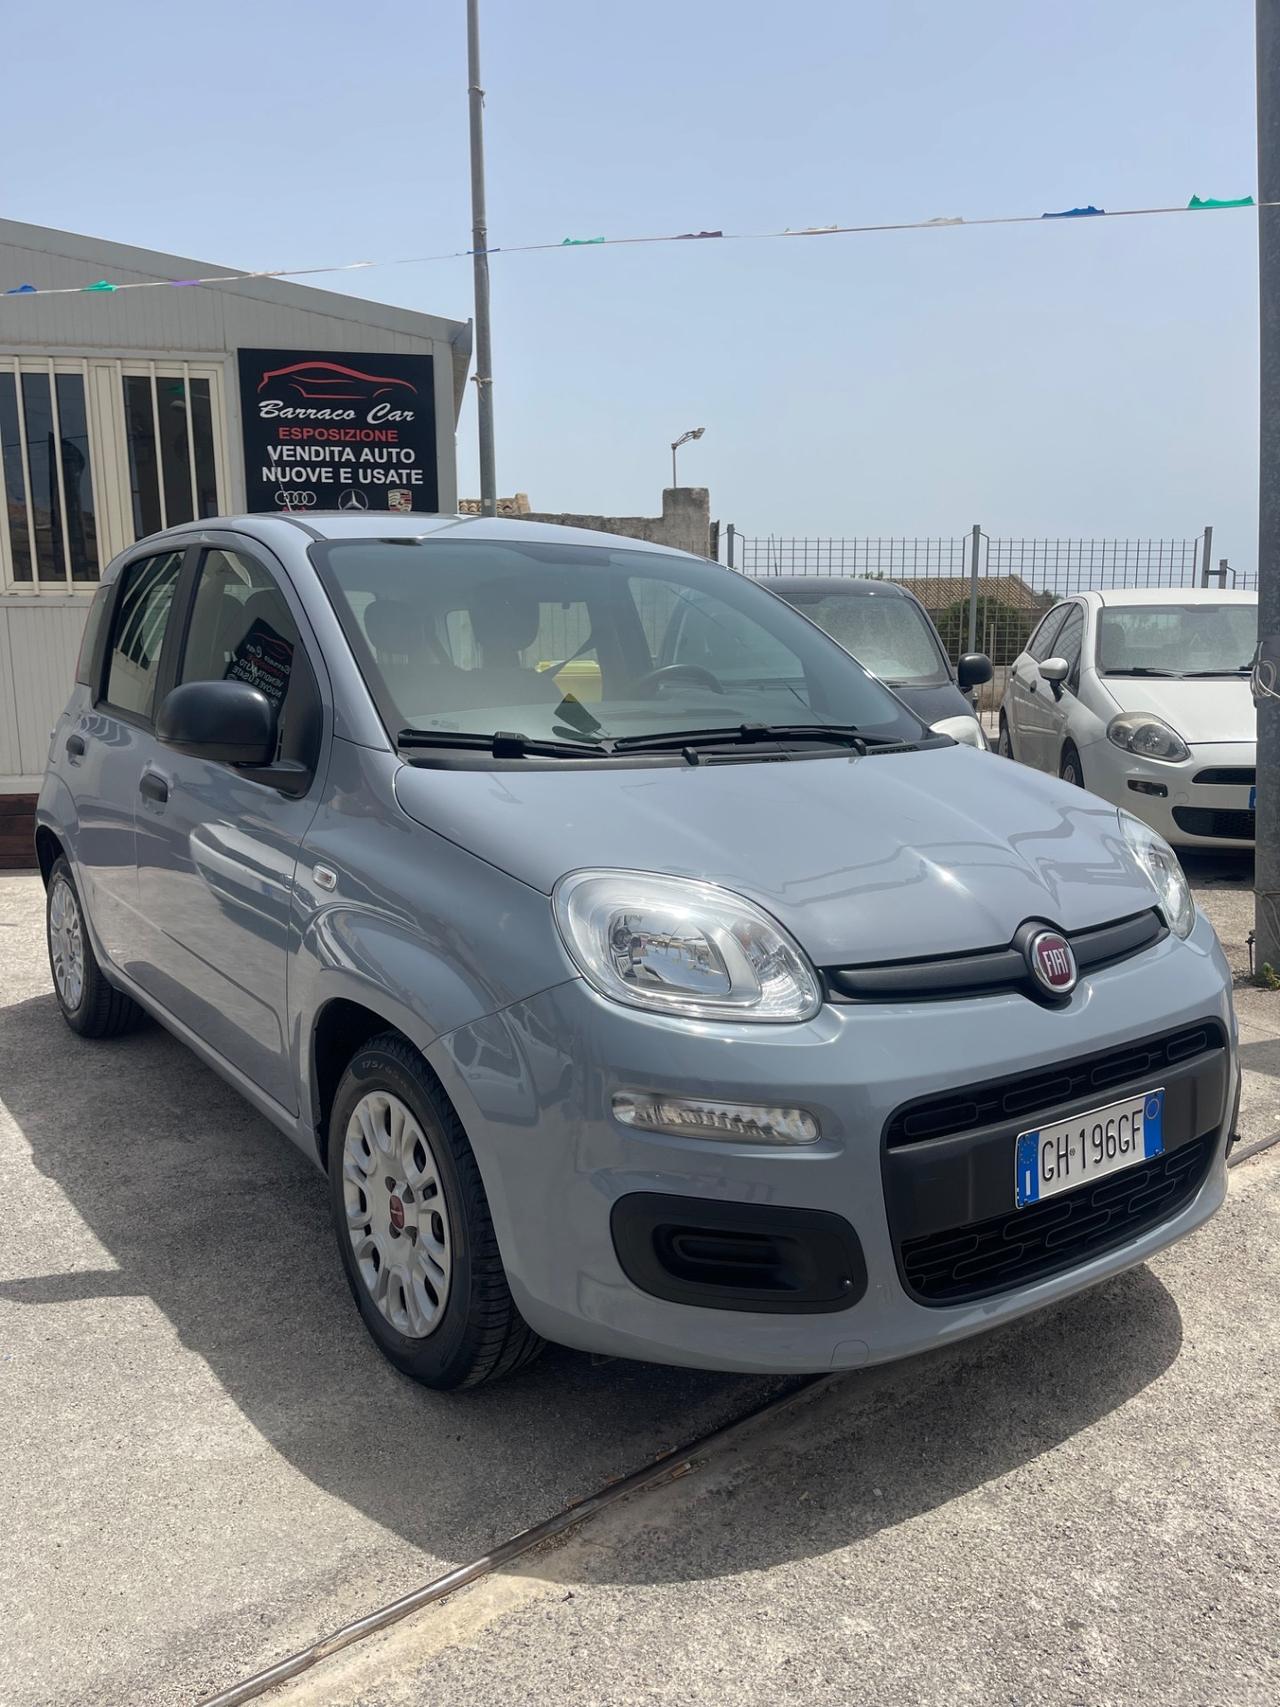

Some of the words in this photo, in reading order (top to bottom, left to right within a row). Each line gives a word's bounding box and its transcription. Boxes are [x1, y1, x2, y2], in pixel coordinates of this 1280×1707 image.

[258, 400, 356, 420] Barraco
[366, 403, 416, 424] Car
[278, 427, 398, 442] ESPOSIZIONE
[267, 445, 356, 463] VENDITA
[359, 448, 415, 464] AUTO
[262, 466, 334, 483] NUOVE
[339, 468, 352, 483] E
[358, 469, 424, 485] USATE
[1042, 948, 1069, 977] FIAT
[1041, 1133, 1070, 1182] GH
[1079, 1109, 1143, 1169] 196GF
